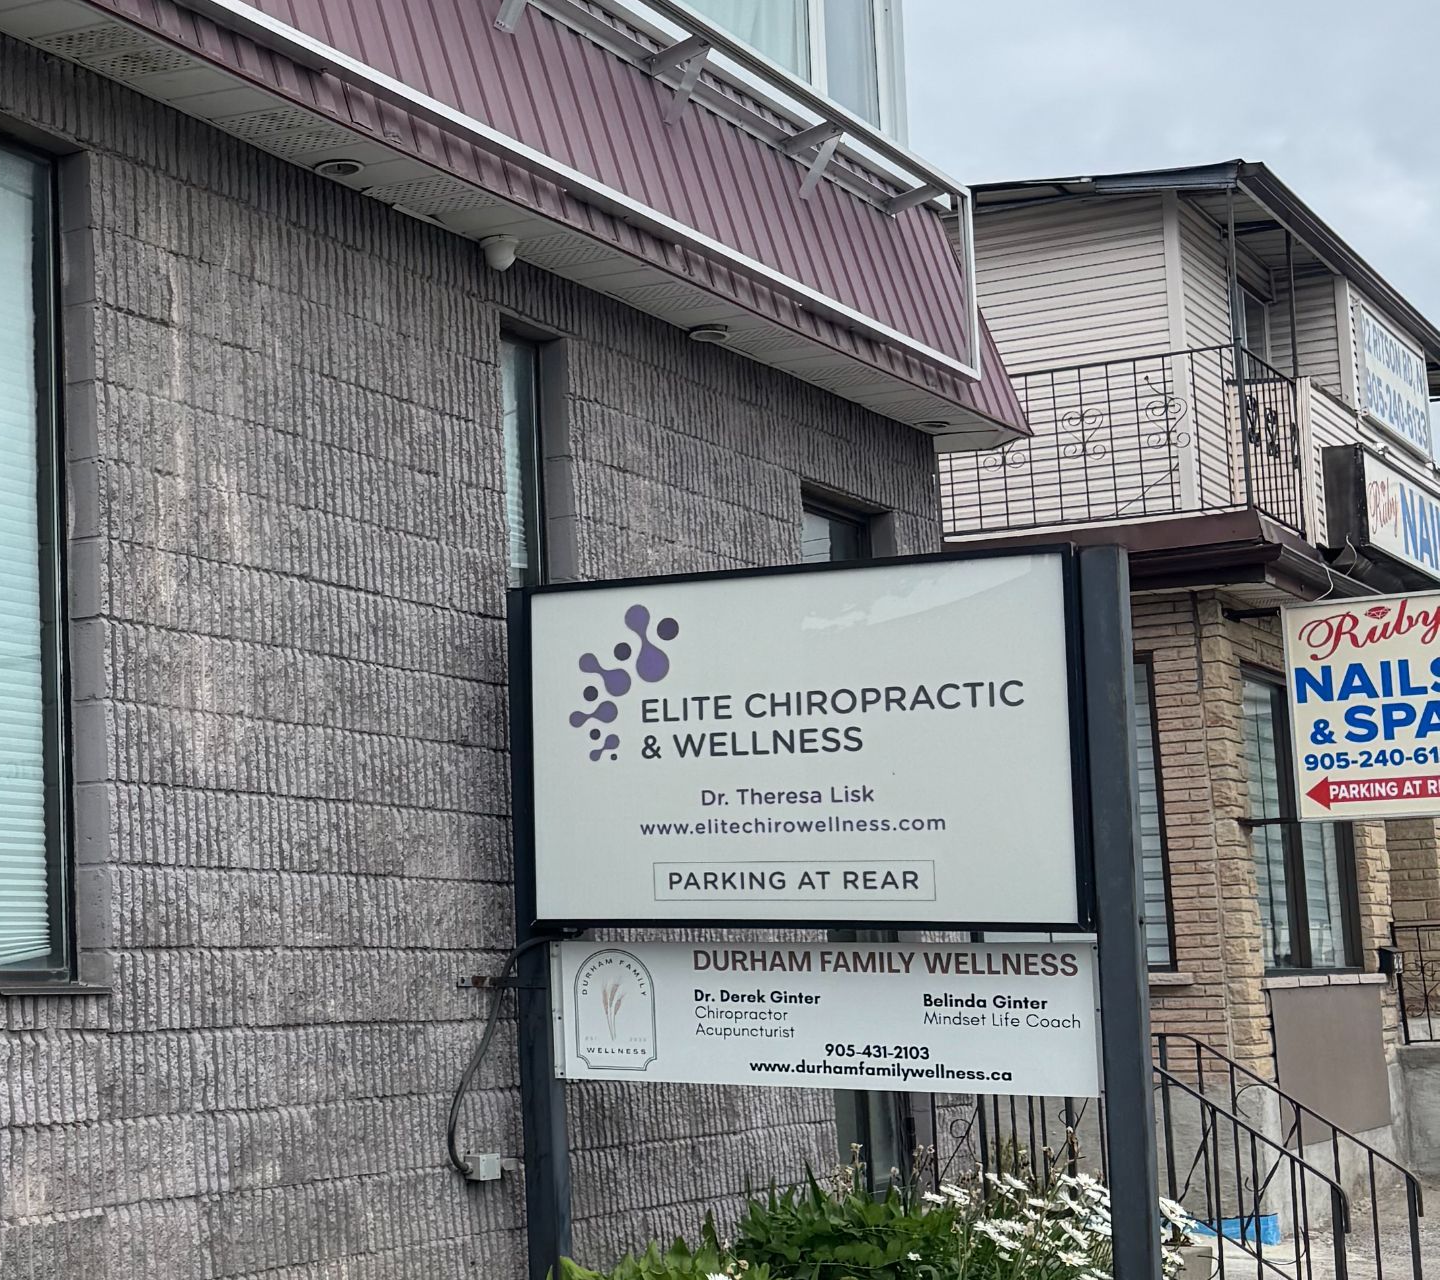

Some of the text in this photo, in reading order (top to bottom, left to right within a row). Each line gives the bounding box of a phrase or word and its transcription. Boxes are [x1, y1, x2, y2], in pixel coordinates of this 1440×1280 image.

[1373, 322, 1402, 379] RITSON
[1367, 367, 1429, 450] 905-240-6133
[1368, 477, 1398, 538] Ruby
[1298, 598, 1440, 661] Ruby
[641, 680, 1024, 723] ELITE CHIROPRACTIC
[1310, 700, 1440, 745] & SPA
[641, 726, 863, 759] & WELLNESS
[1304, 746, 1440, 771] 905-240-61
[701, 785, 875, 806] Dr. Theresa Lisk
[1329, 779, 1440, 800] PARKING AT R
[640, 816, 946, 835] www.elitechirowellness.com
[668, 870, 919, 890] PARKING AT REAR
[693, 950, 1079, 977] DURHAM FAMILY WELLNESS
[582, 958, 647, 996] DURHAM FAMILY
[694, 989, 821, 1005] Dr. Derek Ginter
[923, 993, 1048, 1010] Belinda Ginter
[694, 1005, 788, 1023] Chiropractor
[923, 1011, 1081, 1029] Mindset Life Coach
[695, 1022, 795, 1040] Acupuncturist
[586, 1047, 647, 1055] WELLNESS
[825, 1043, 930, 1060] 905-431-2103
[750, 1059, 1013, 1082] www.durhamfamilywellness.ca
